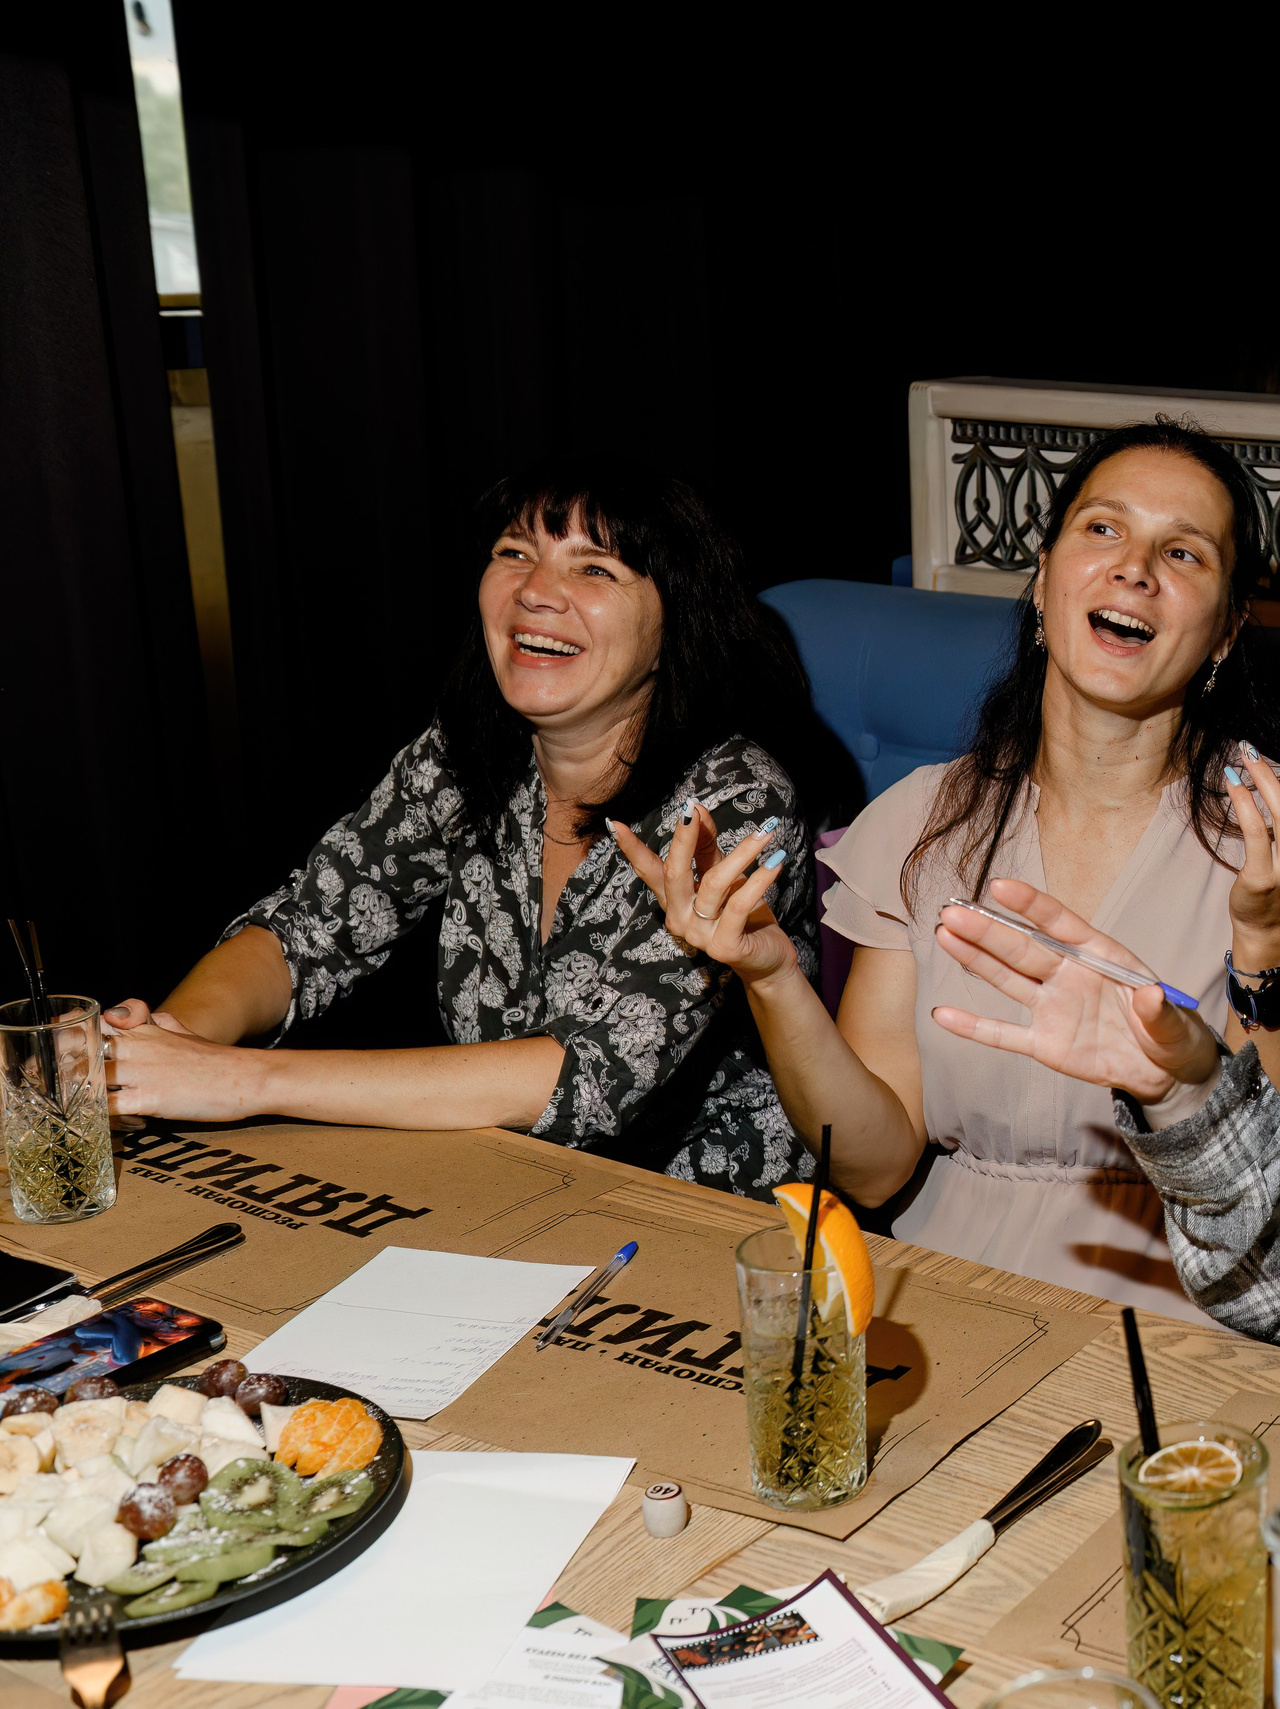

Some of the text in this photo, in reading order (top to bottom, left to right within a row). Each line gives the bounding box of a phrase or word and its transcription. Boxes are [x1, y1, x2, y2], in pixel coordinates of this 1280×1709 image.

[125, 1166, 309, 1230] РЕСТОРАН ПАБ
[650, 1485, 675, 1496] 46
